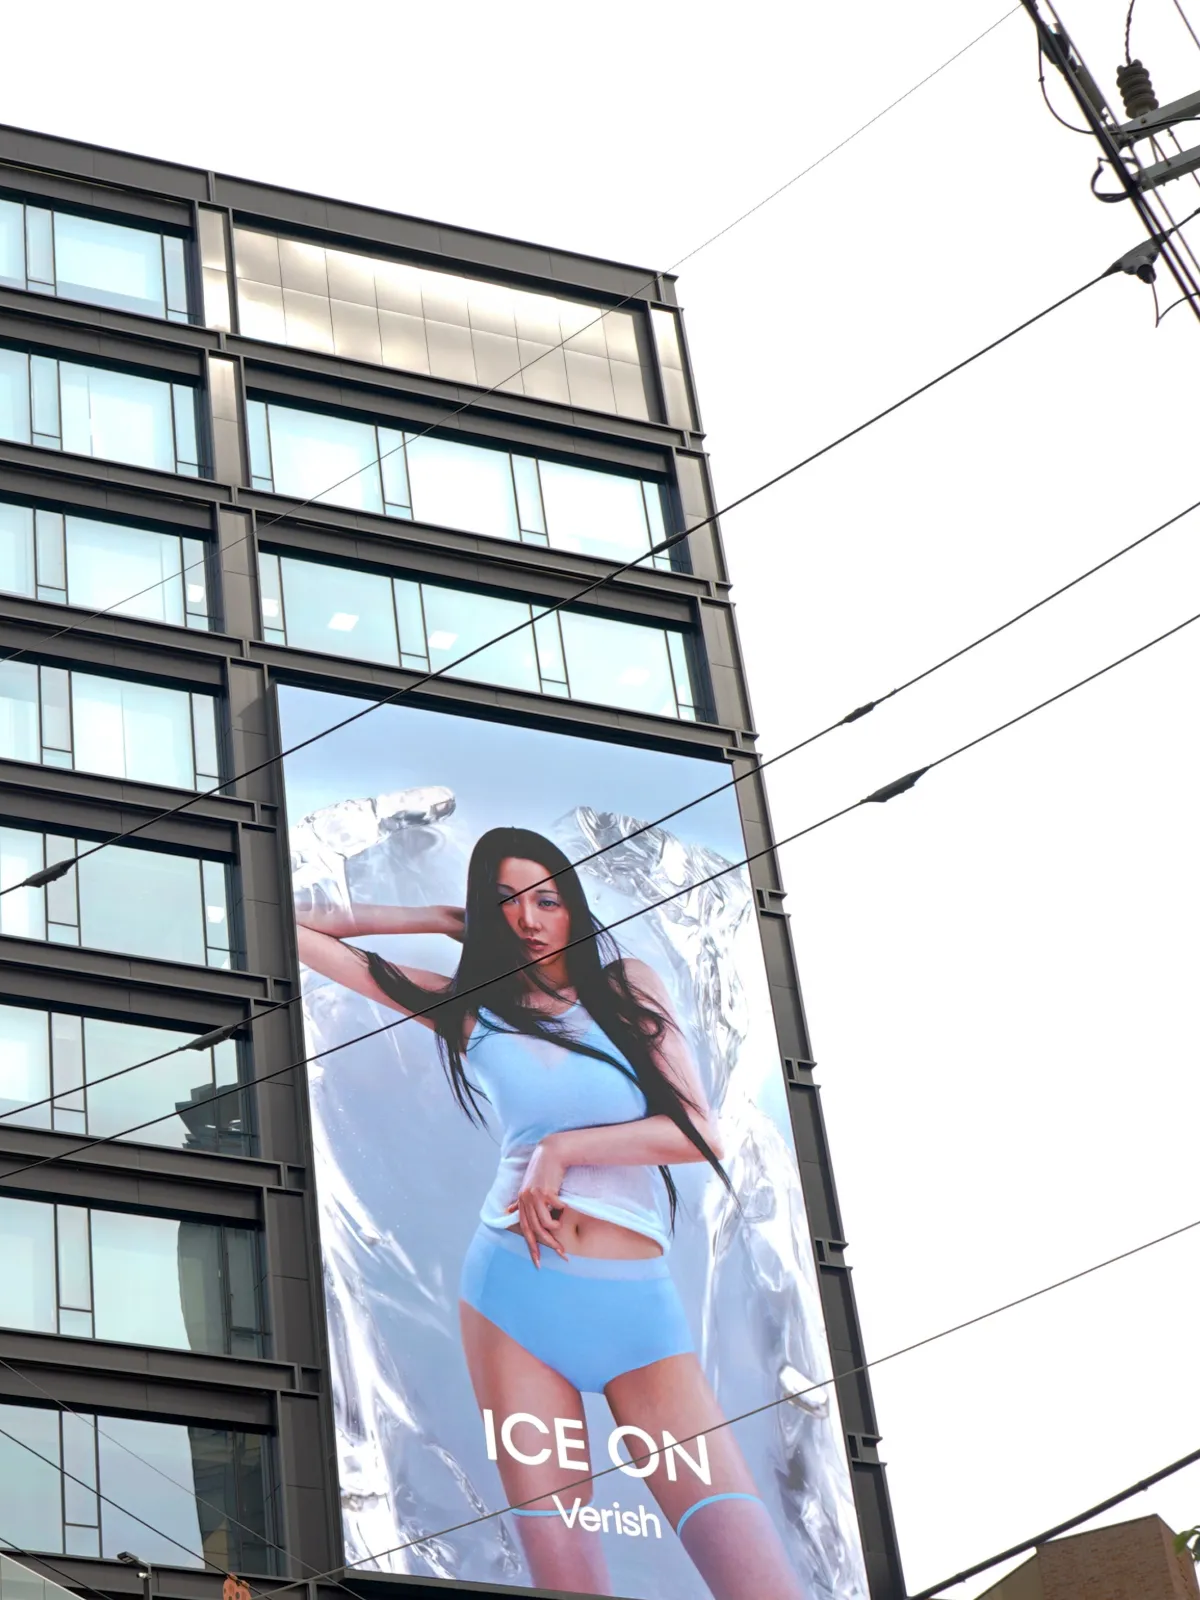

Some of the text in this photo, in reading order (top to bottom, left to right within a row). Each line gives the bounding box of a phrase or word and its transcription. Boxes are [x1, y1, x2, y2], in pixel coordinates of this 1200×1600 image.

[483, 1409, 712, 1485] ICE ON
[551, 1494, 662, 1539] Verish
